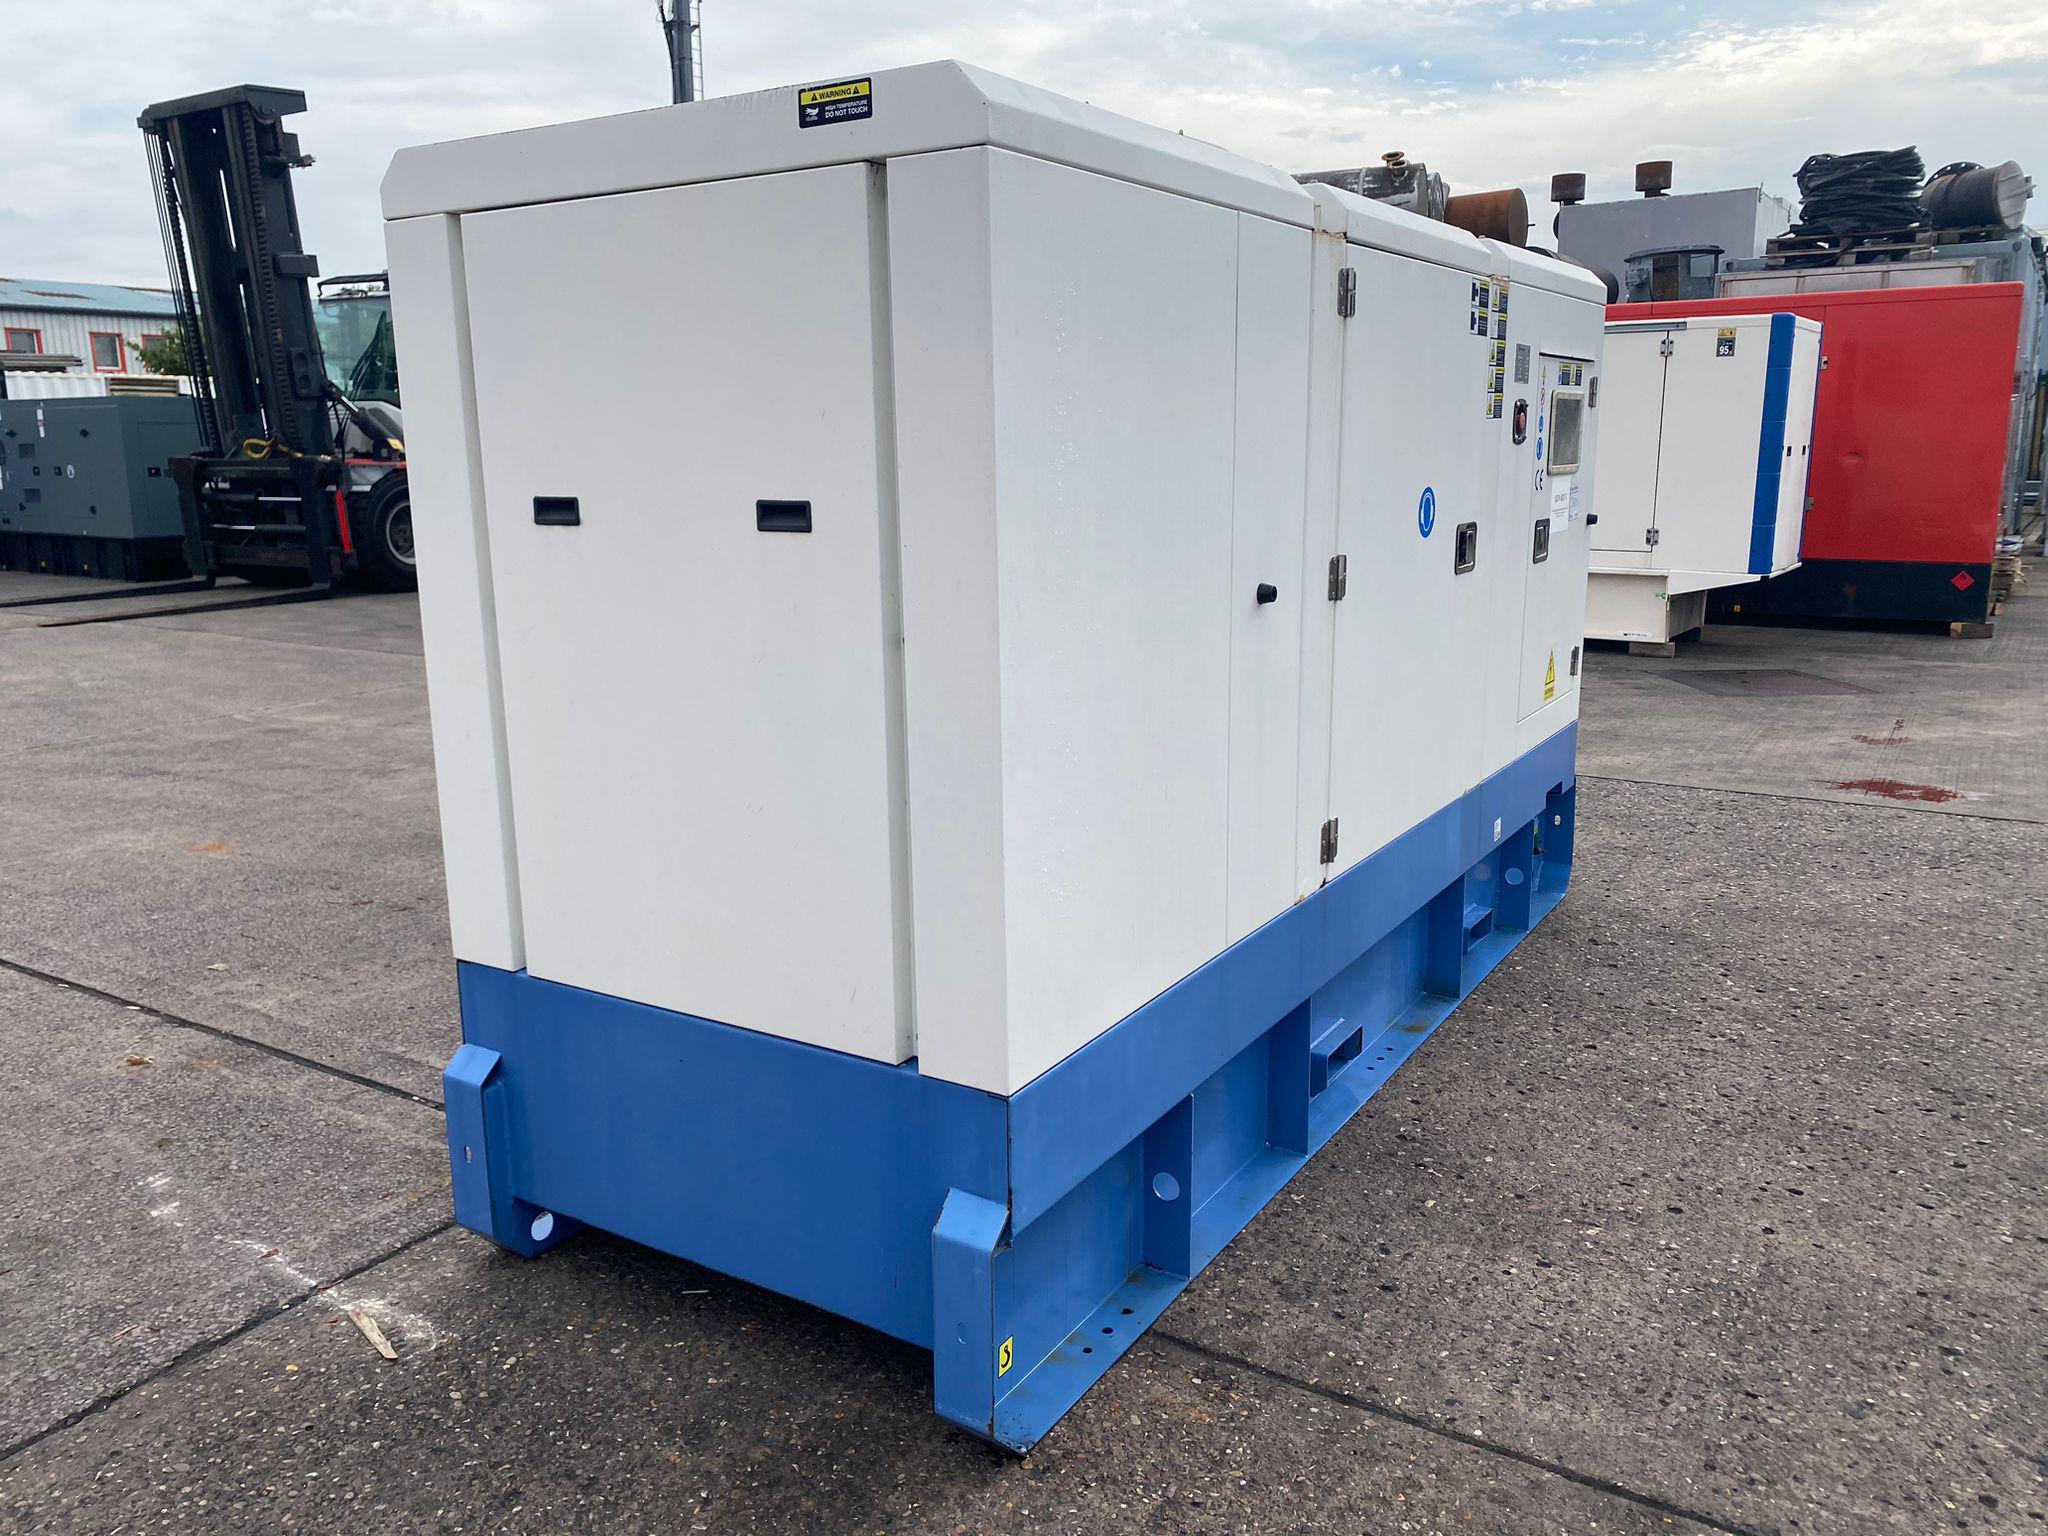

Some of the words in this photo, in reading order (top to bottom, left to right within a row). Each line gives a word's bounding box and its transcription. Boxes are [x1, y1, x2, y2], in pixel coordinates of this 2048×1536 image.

[819, 88, 852, 100] WARNING
[825, 110, 835, 119] DO
[835, 108, 847, 117] NOT
[848, 106, 868, 115] TOUCH
[1719, 345, 1730, 355] 95
